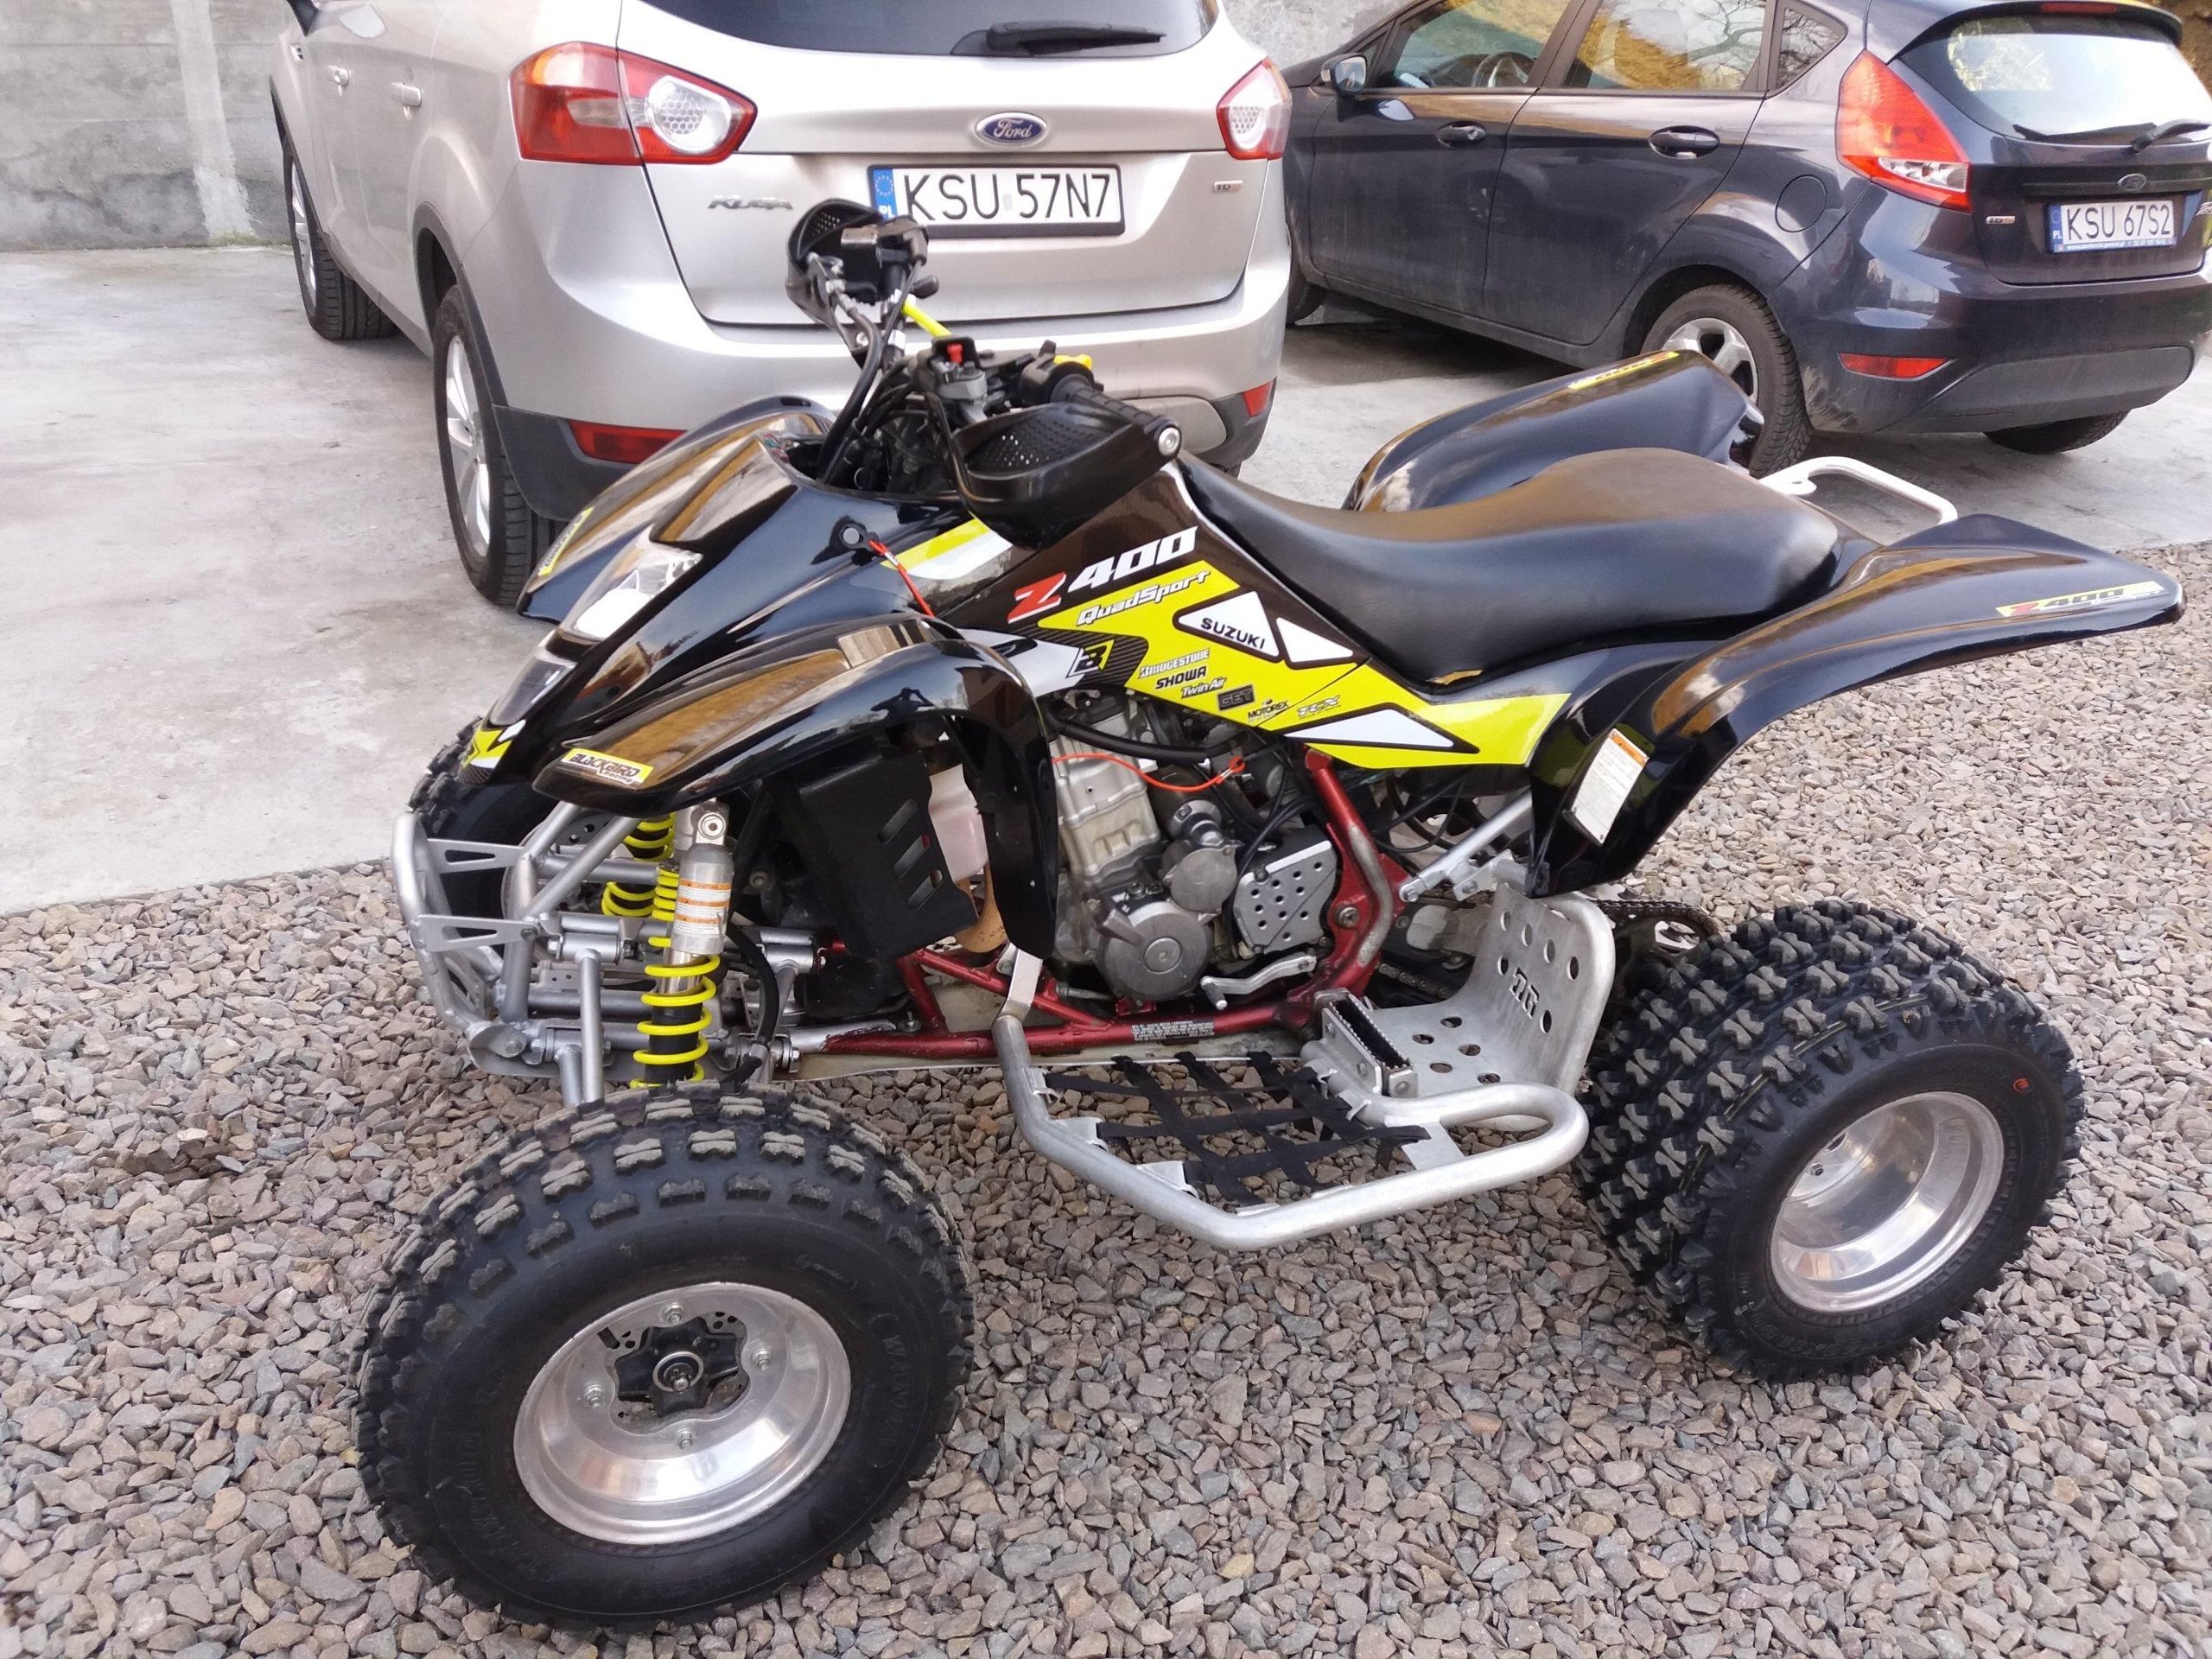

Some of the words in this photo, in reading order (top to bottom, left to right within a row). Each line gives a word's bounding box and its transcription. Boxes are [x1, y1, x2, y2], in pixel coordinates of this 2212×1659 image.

[993, 118, 1033, 138] Ford
[904, 174, 1000, 220] KSU
[1015, 173, 1110, 219] 57N7
[2067, 207, 2115, 240] KSU
[2124, 204, 2171, 236] 67S2
[1076, 569, 1211, 627] QuadSport
[1200, 617, 1267, 650] SUZUKI
[1139, 648, 1210, 679] BRIDGESTONE
[1155, 665, 1207, 690] SHOWA
[1181, 683, 1211, 699] Twin
[1209, 677, 1227, 692] Air
[1248, 700, 1289, 720] MOTOREX
[569, 753, 641, 778] BLACKBIRD
